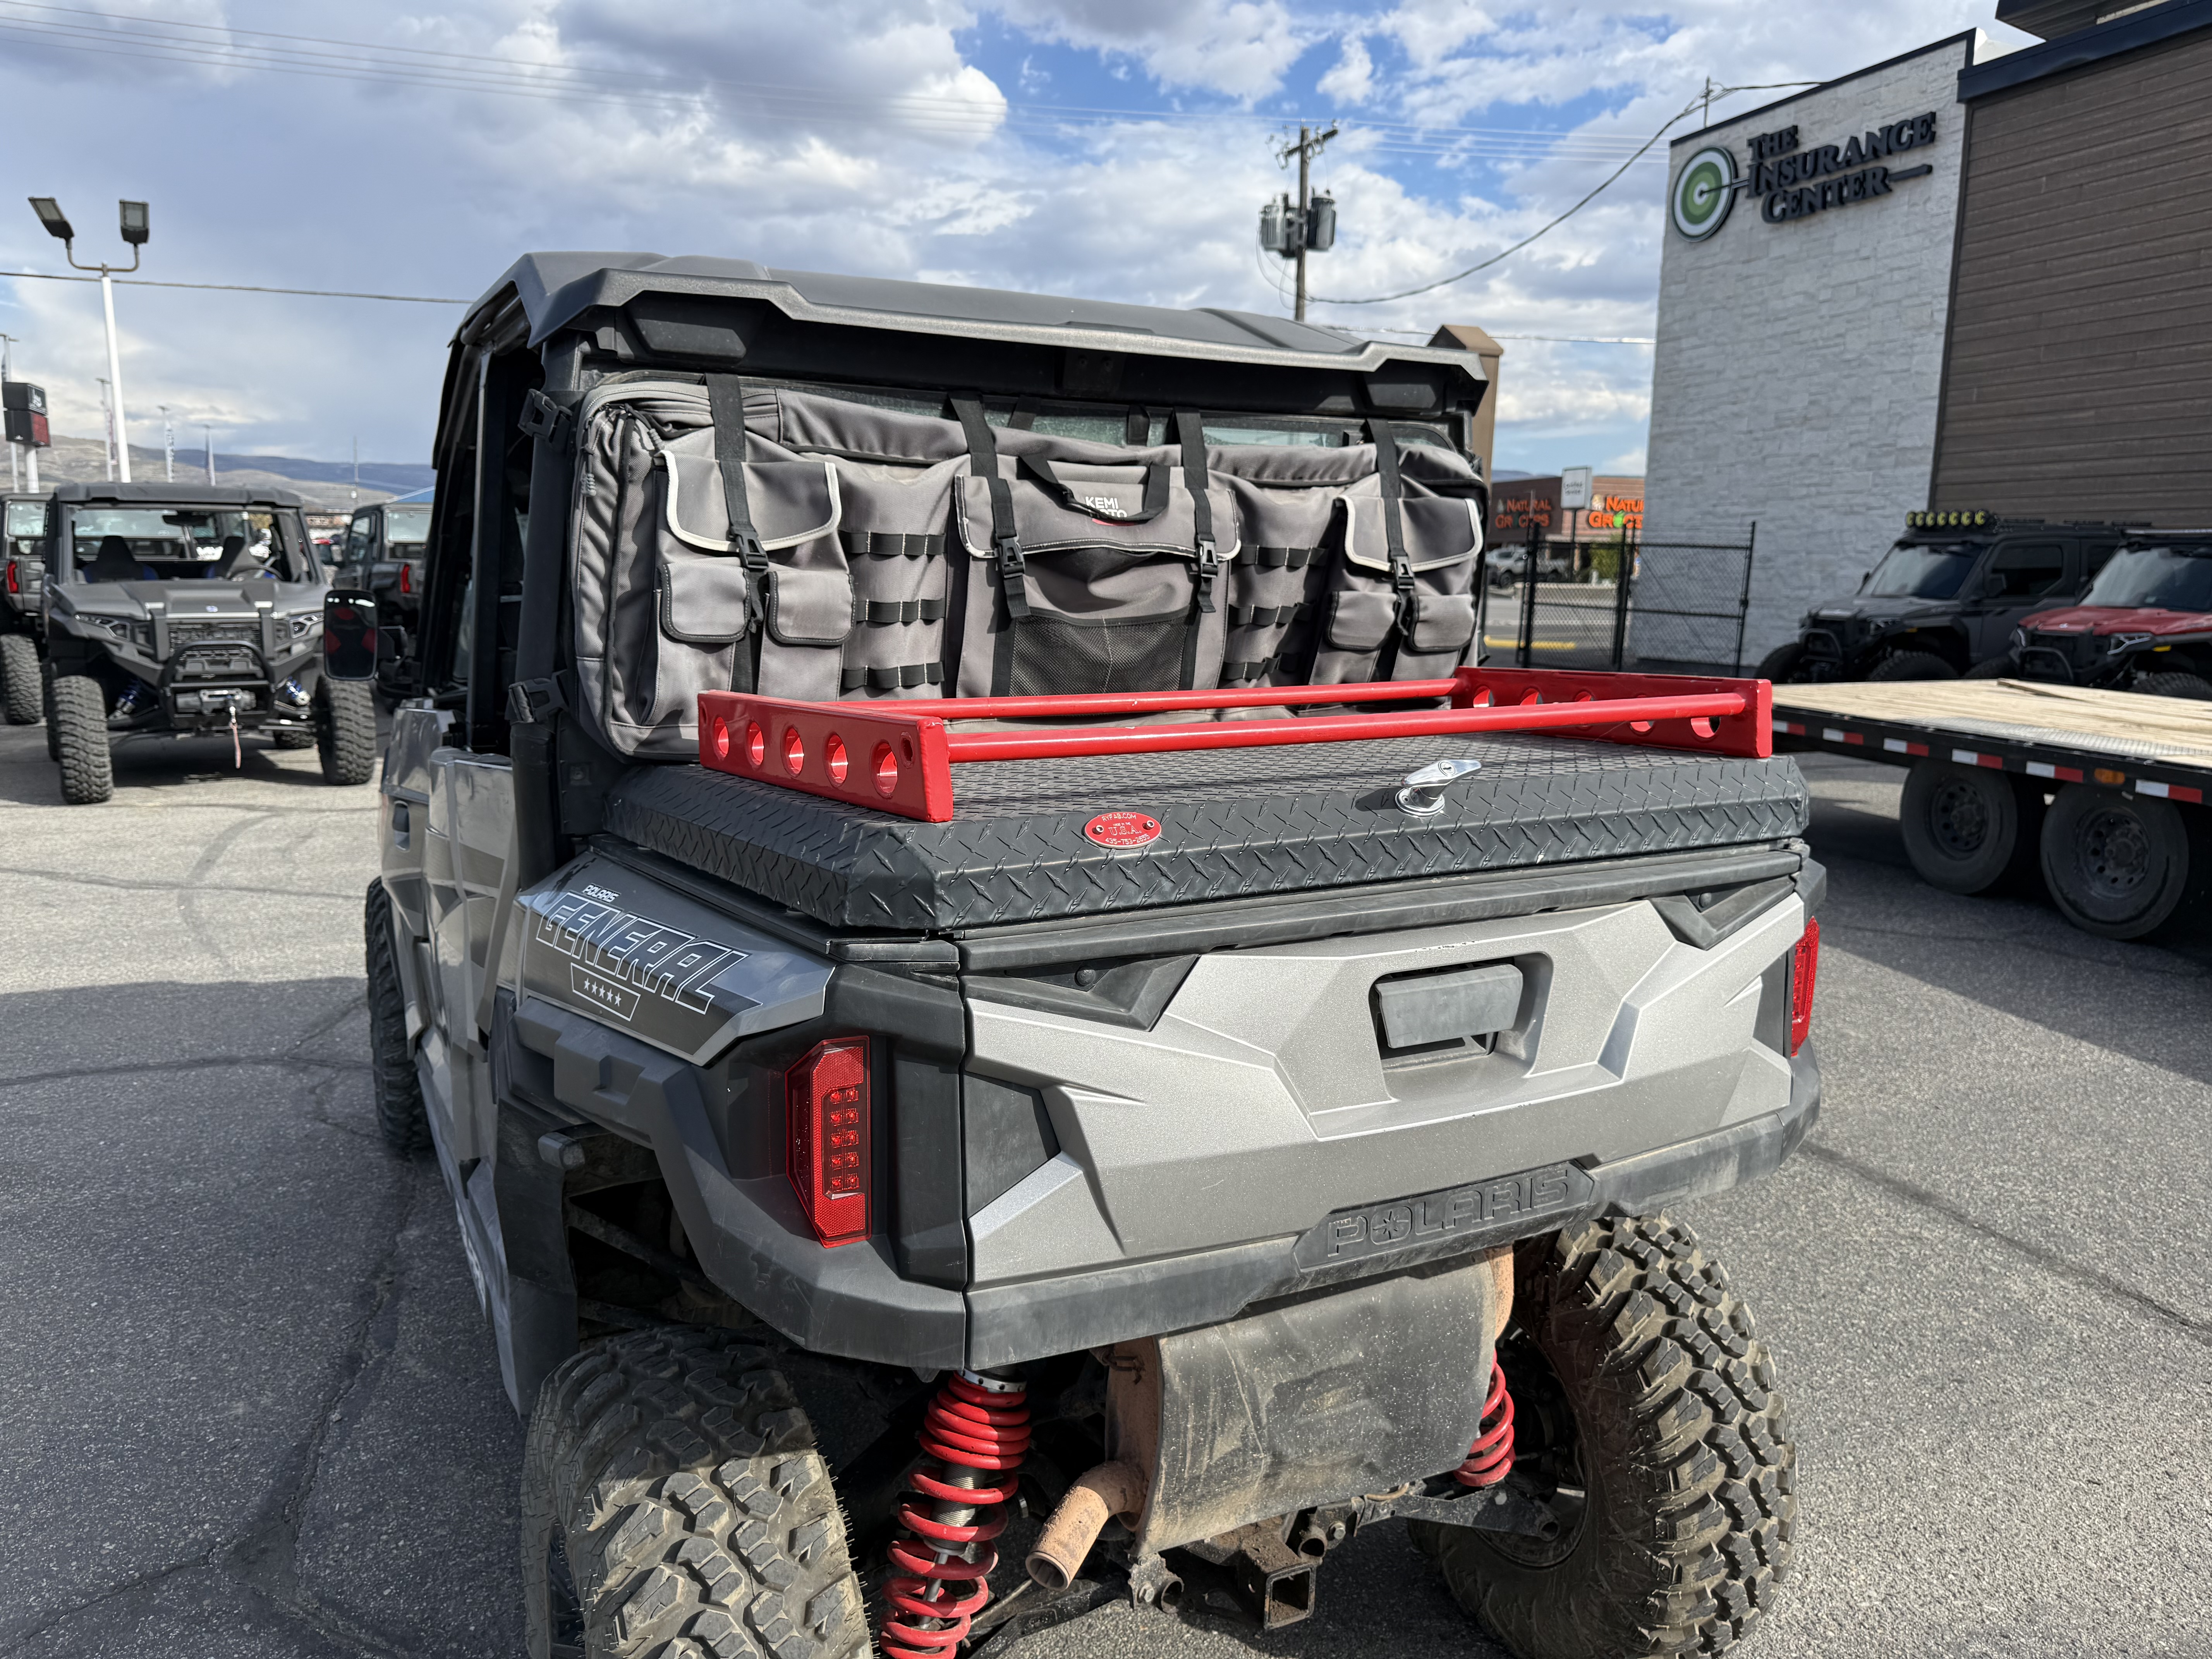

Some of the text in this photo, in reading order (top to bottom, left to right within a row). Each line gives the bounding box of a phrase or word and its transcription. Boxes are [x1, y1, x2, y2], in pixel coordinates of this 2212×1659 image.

[1746, 111, 1936, 198] INSURANCE
[1747, 125, 1799, 162] THE
[1761, 166, 1892, 224] CENTER
[1085, 496, 1118, 509] KEMI
[1102, 813, 1136, 821] RYFAB.COM
[582, 884, 620, 903] POLARIS
[536, 891, 750, 1015] GENERAL
[1328, 1169, 1568, 1257] POLARIS
